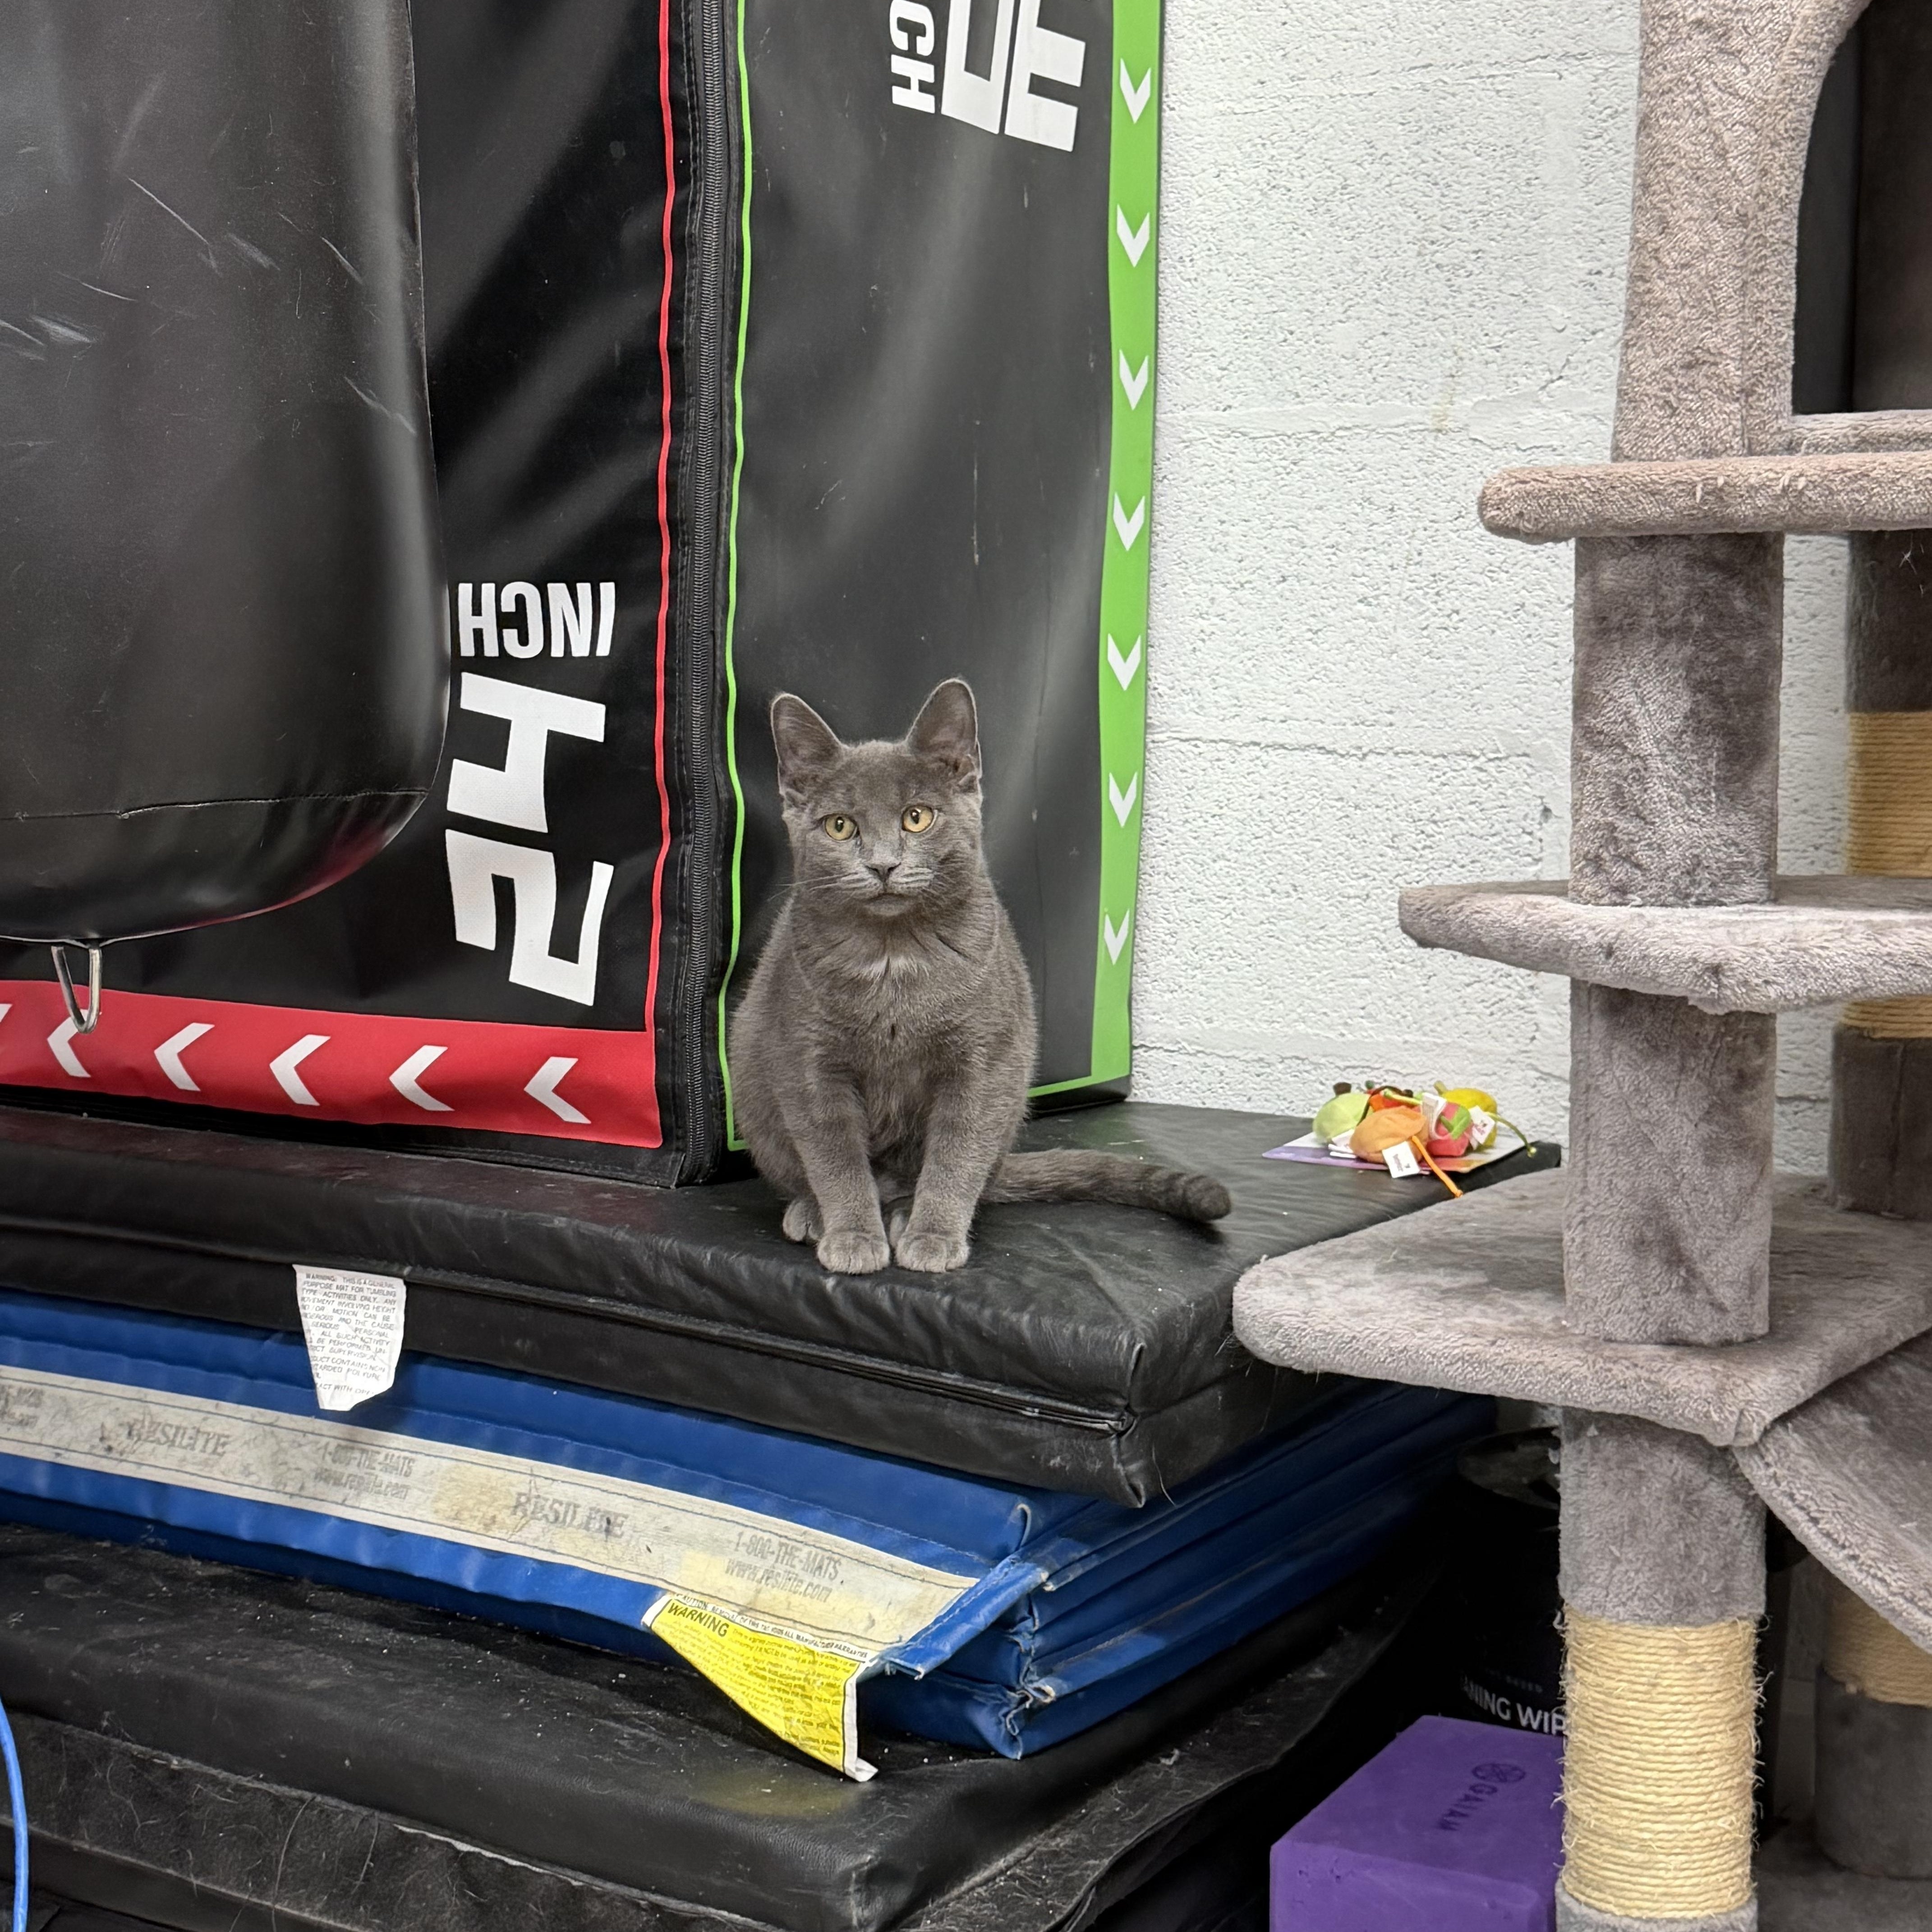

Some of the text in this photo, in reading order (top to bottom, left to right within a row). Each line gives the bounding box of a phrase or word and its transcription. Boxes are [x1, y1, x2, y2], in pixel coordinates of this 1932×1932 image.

[458, 581, 615, 658] INCH
[445, 672, 614, 1007] 24
[667, 1602, 730, 1638] WARNING
